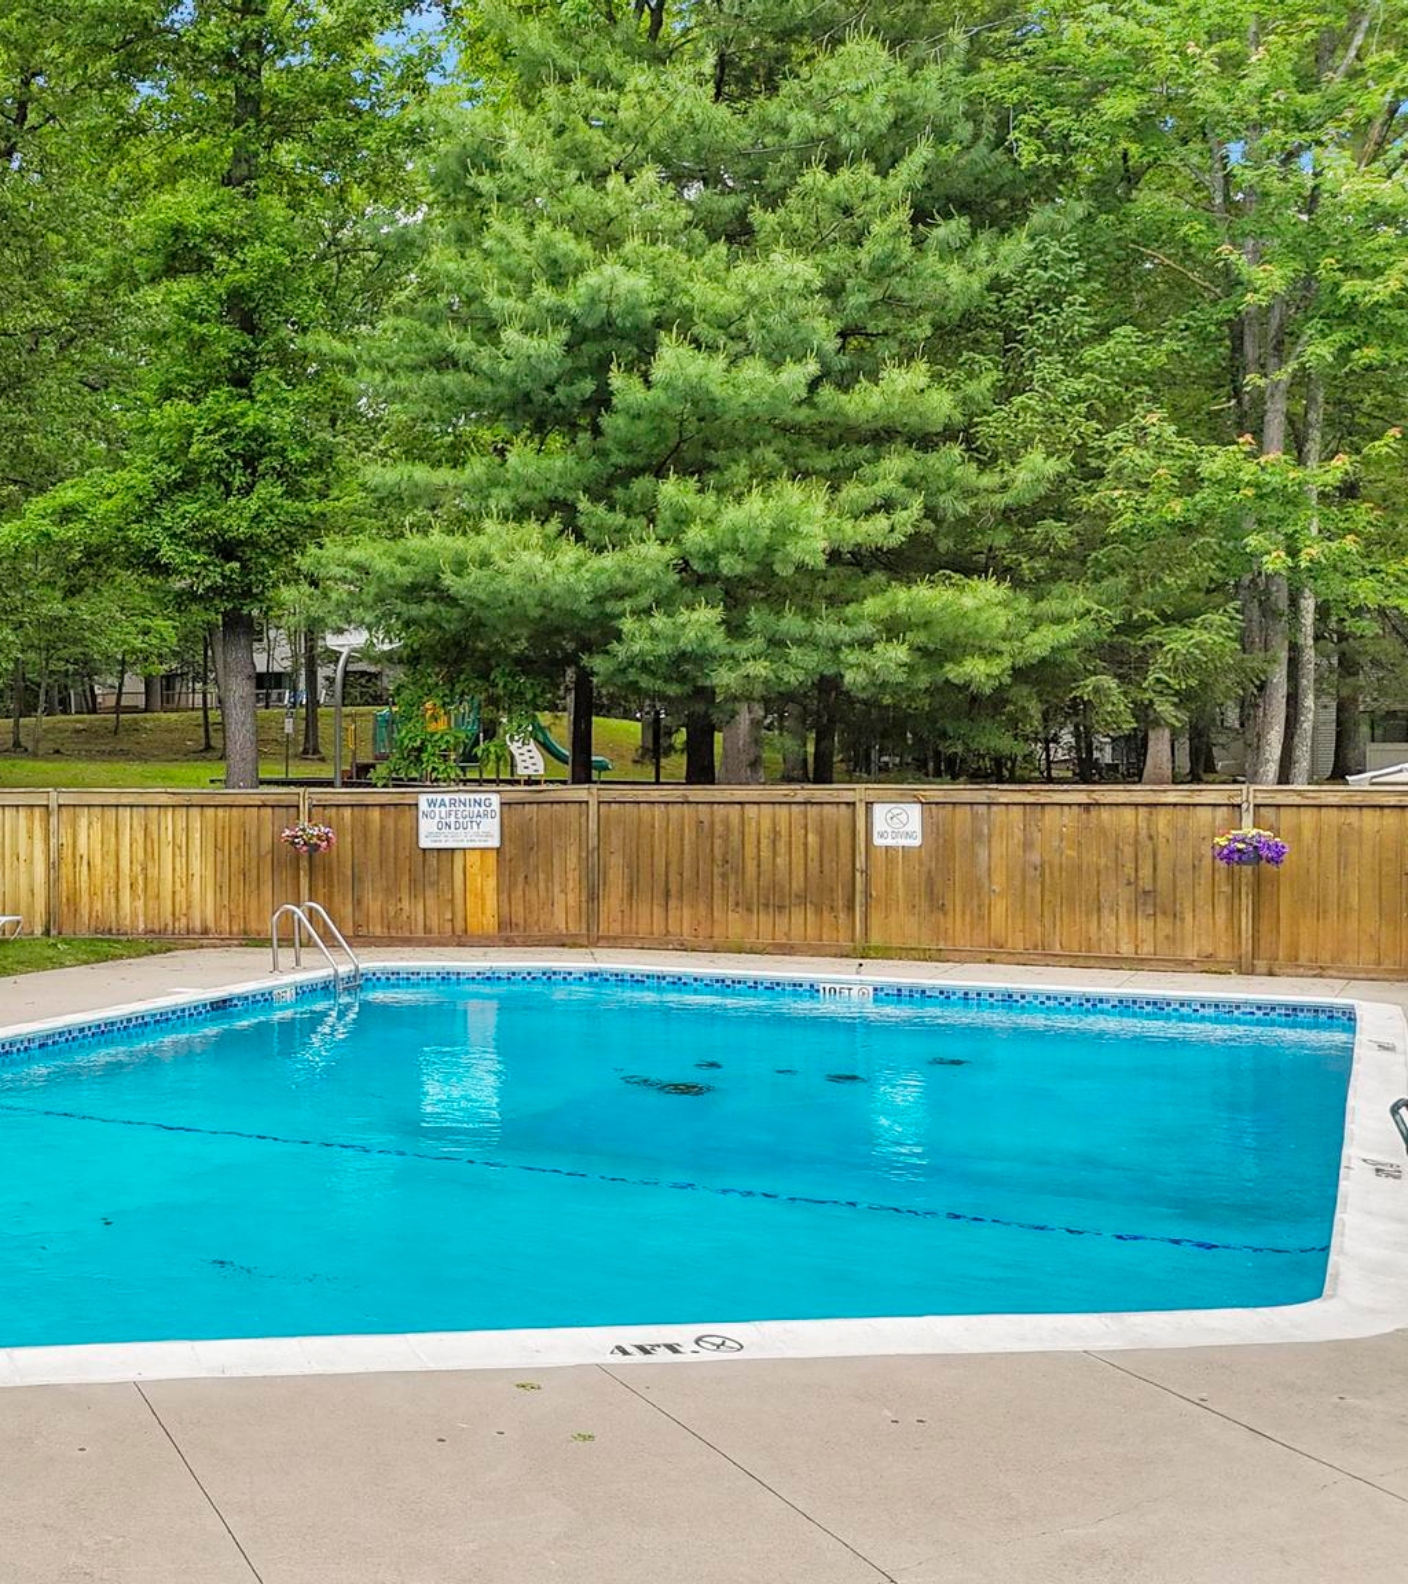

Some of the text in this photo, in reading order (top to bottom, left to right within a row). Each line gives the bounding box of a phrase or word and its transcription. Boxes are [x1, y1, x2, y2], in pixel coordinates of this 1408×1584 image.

[426, 797, 492, 808] WARNING
[421, 809, 497, 820] NO LIFEGUARD
[436, 820, 482, 830] ON DUTY
[877, 830, 917, 840] NO DIVING
